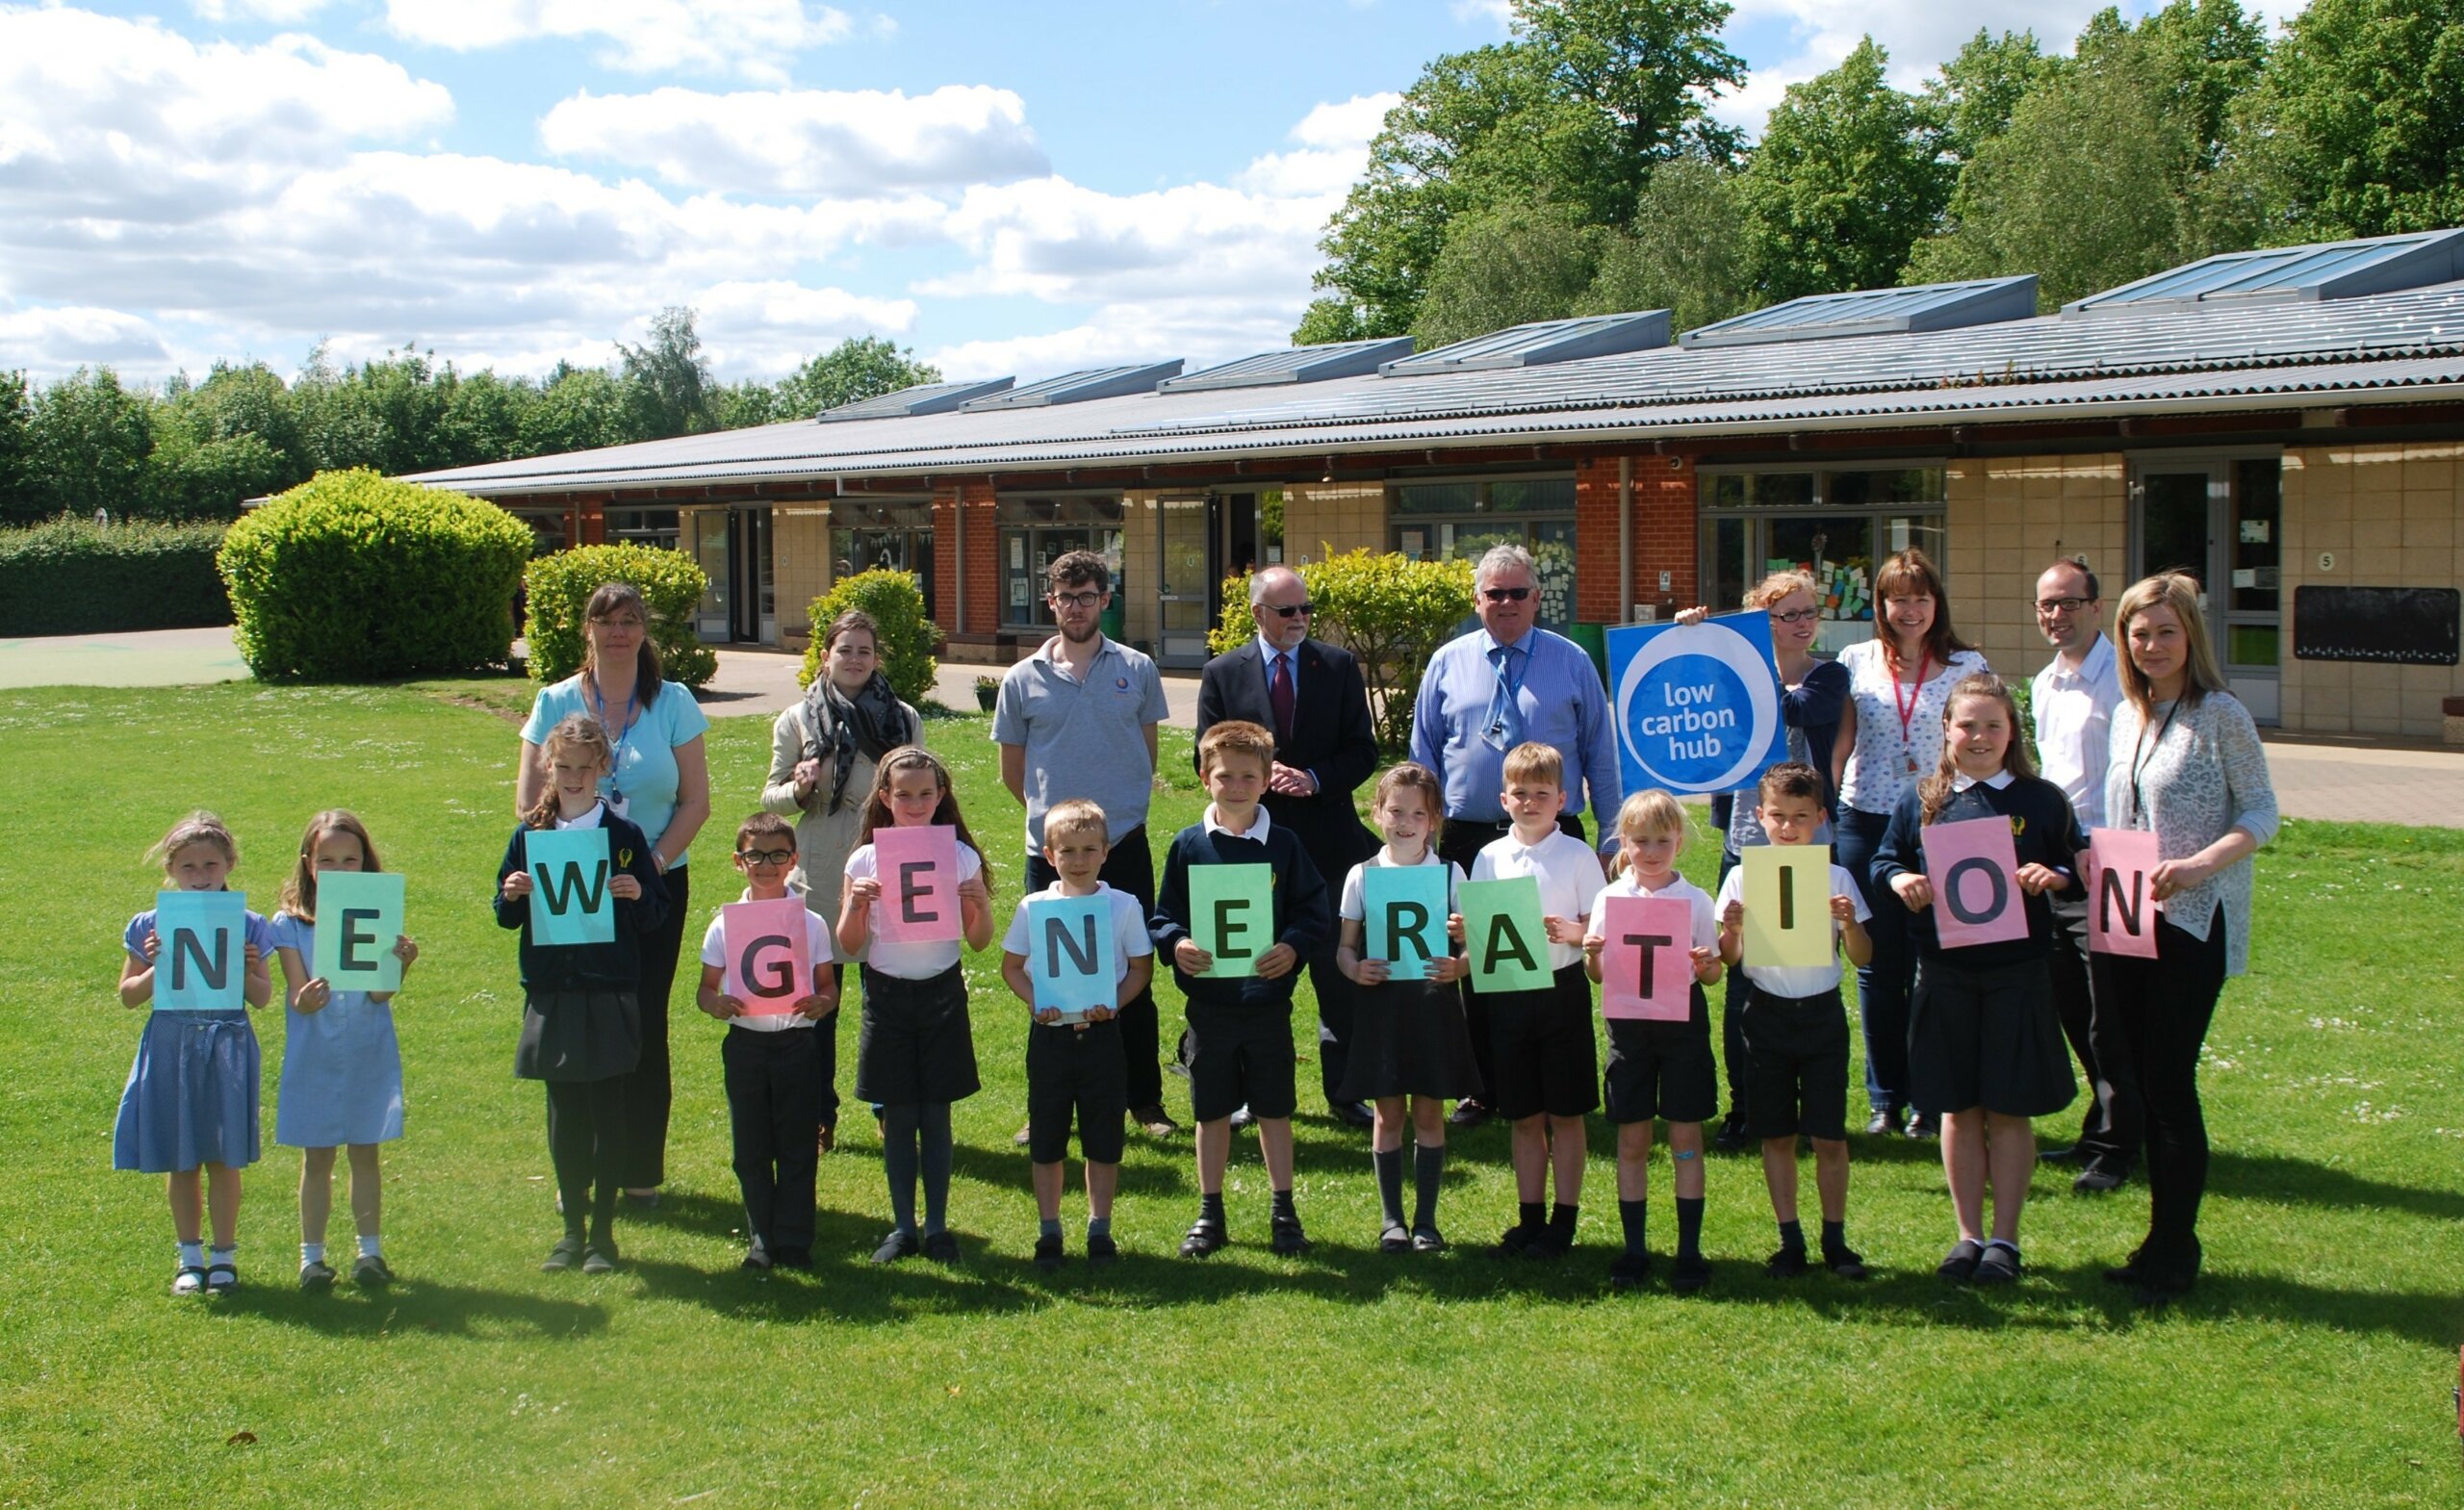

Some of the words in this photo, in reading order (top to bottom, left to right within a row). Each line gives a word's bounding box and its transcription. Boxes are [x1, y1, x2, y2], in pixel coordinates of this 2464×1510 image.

[1641, 707, 1735, 736] carbon
[1664, 681, 1714, 707] low
[1669, 732, 1722, 761] hub
[535, 859, 608, 915] W
[900, 861, 938, 923] E
[1780, 866, 1793, 929] I
[1945, 857, 2008, 924] O
[2100, 867, 2143, 936] N
[171, 928, 227, 990] N
[340, 909, 379, 971] E
[1045, 914, 1098, 978] N
[1215, 900, 1251, 959] E
[1386, 901, 1432, 961] R
[1483, 914, 1537, 974] A
[741, 935, 794, 998] G
[1624, 934, 1672, 999] T
